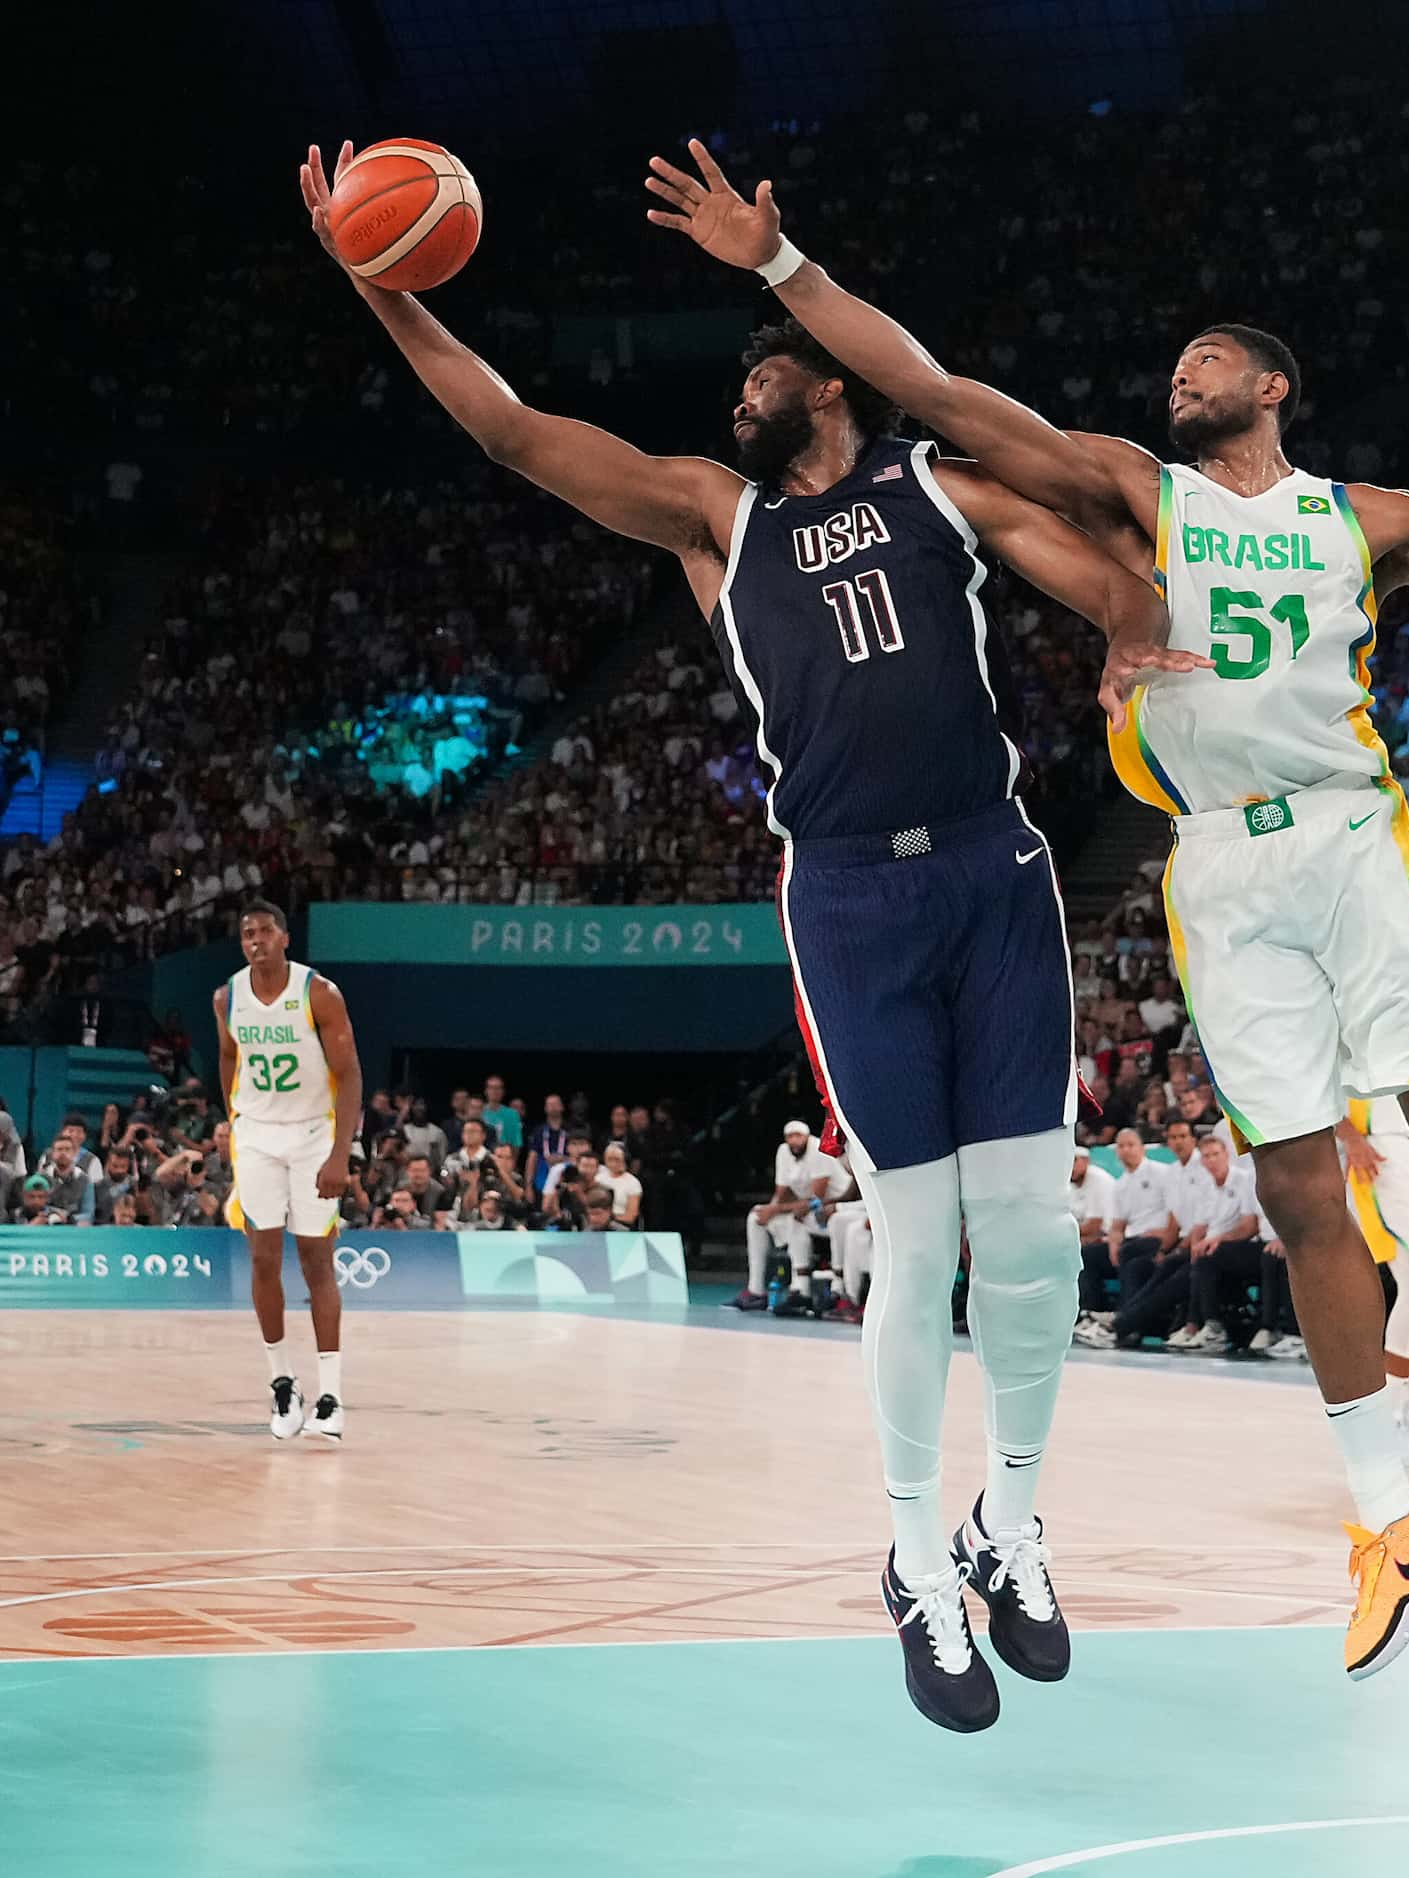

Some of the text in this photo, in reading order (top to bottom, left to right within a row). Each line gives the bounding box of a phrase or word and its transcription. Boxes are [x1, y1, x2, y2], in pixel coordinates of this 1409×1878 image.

[793, 503, 891, 573] USA
[1183, 522, 1326, 571] BRASIL
[822, 568, 905, 663] 11
[1210, 586, 1310, 680] 51
[471, 919, 743, 953] PARIS 2024
[237, 1024, 303, 1044] BRASIL
[248, 1053, 301, 1093] 32
[9, 1253, 212, 1277] PARIS 2024
